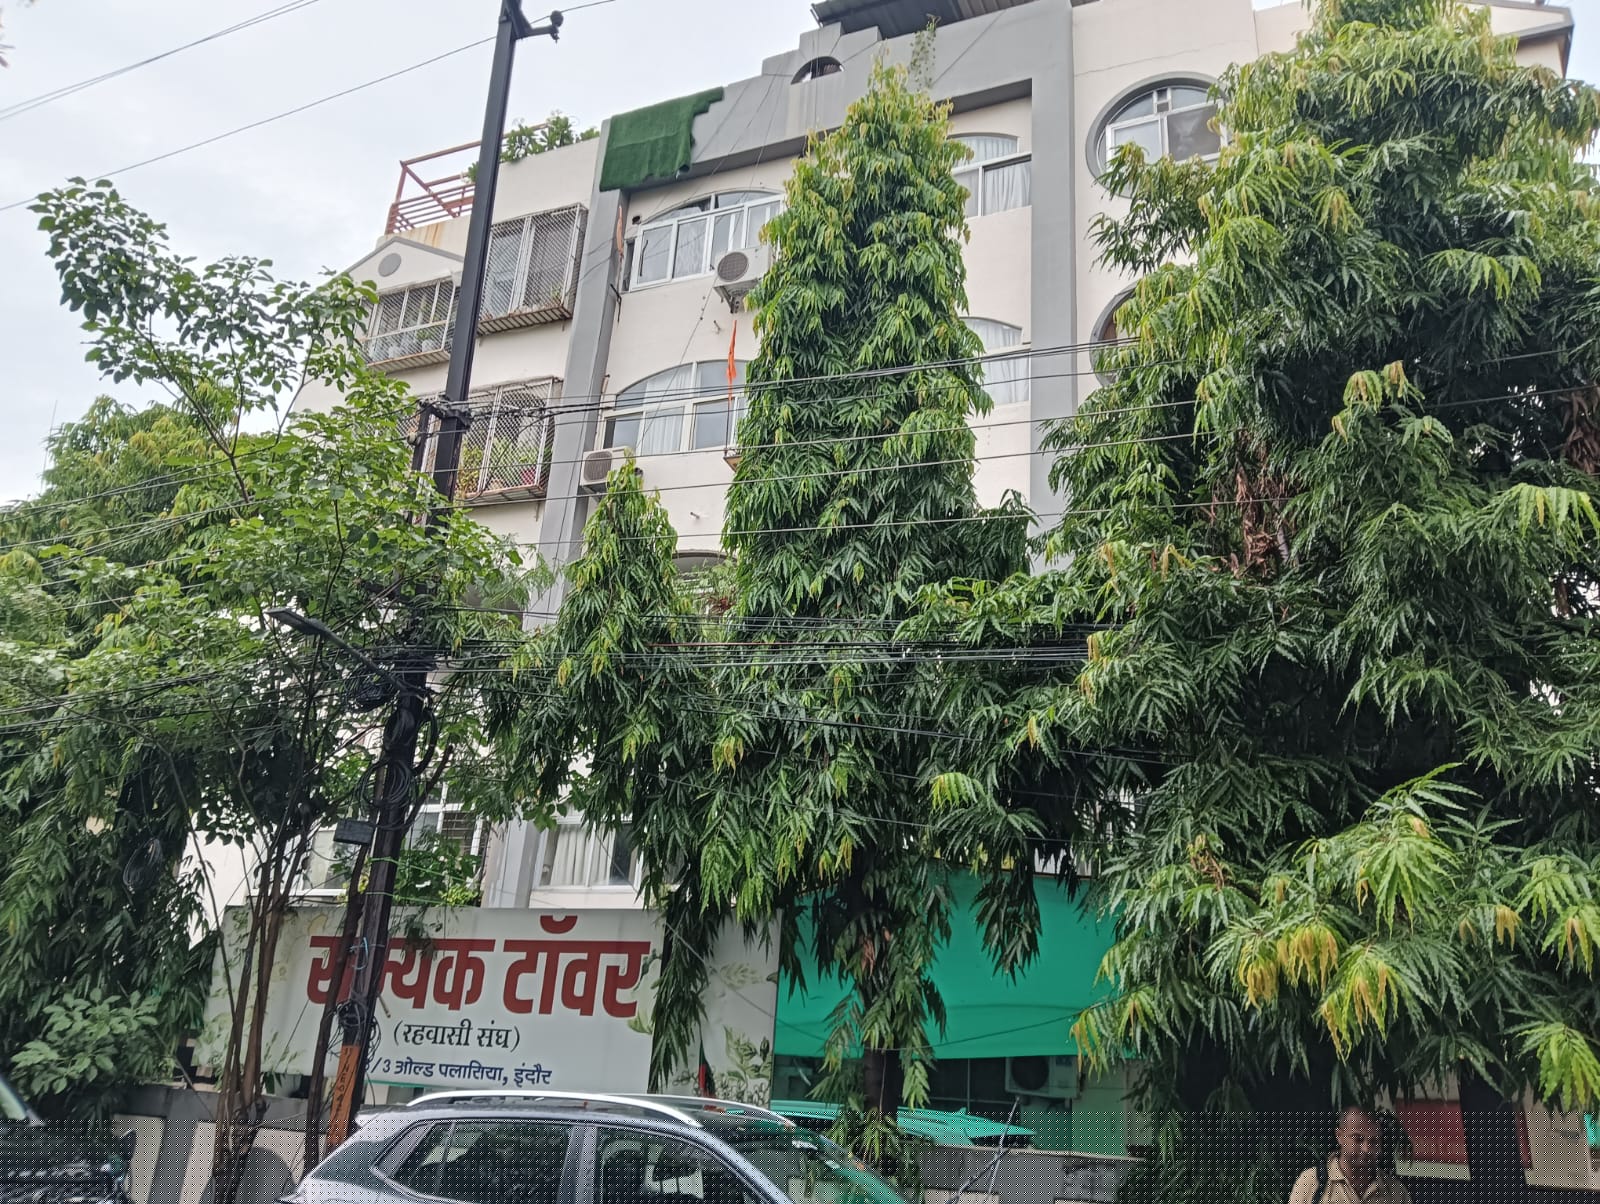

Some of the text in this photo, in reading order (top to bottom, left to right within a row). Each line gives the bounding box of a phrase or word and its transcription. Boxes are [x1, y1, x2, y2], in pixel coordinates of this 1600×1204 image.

[503, 915, 651, 1018] टॉवर
[394, 1019, 520, 1053] (रहवासी संघ)
[394, 1056, 435, 1077] ओल्ड
[513, 1062, 552, 1087] इंदौर
